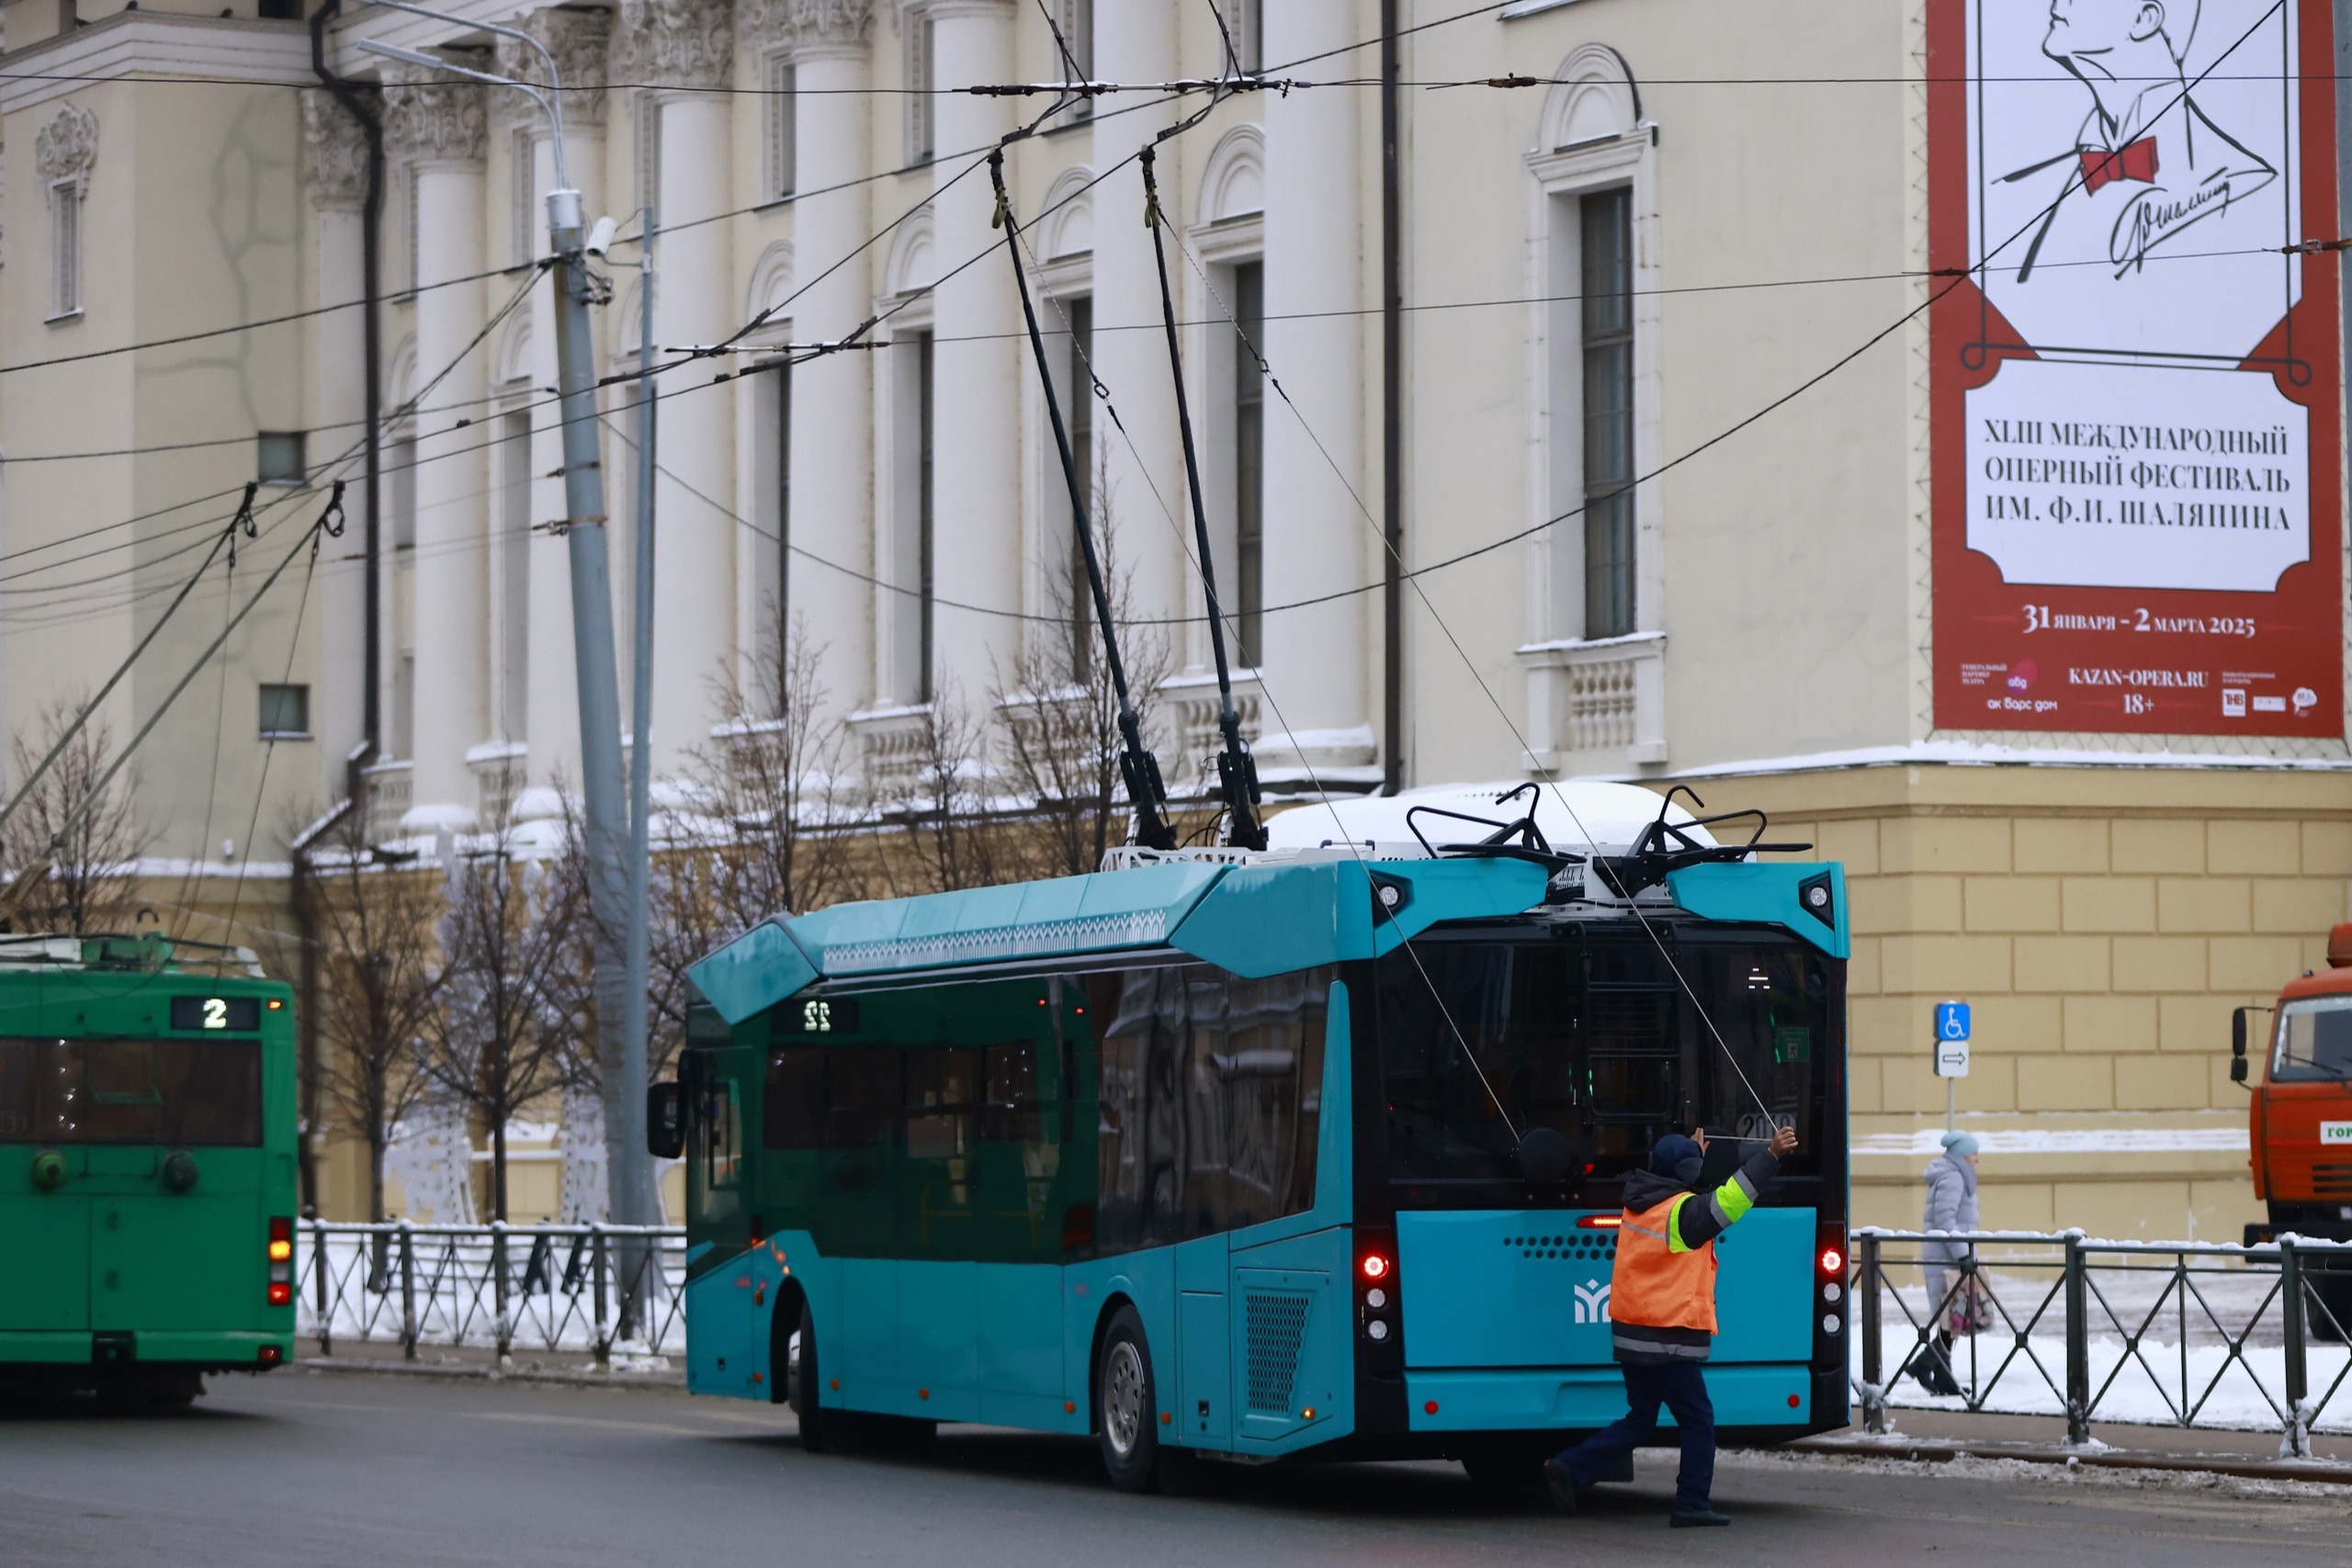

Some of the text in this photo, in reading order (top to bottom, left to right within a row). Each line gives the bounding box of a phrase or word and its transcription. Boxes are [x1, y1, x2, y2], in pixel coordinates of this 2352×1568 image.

[1984, 419, 2288, 457] XLIII МЕЖДУНАРОДНЫЙ
[1985, 455, 2290, 493] ОПЕРНЫЙ ФЕСТИВАЛЬ
[1986, 494, 2290, 530] ИМ. Ф.И. ШАЛЯПИНА
[2022, 604, 2051, 634] 31
[2053, 614, 2116, 631] ЯНВАРЯ
[2134, 608, 2151, 632] 2
[2154, 617, 2206, 633] МАРТА
[2209, 616, 2256, 638] 2025
[2069, 667, 2209, 688] KAZAN-OPERA.RU
[2123, 694, 2154, 715] 18+
[203, 998, 226, 1029] 2
